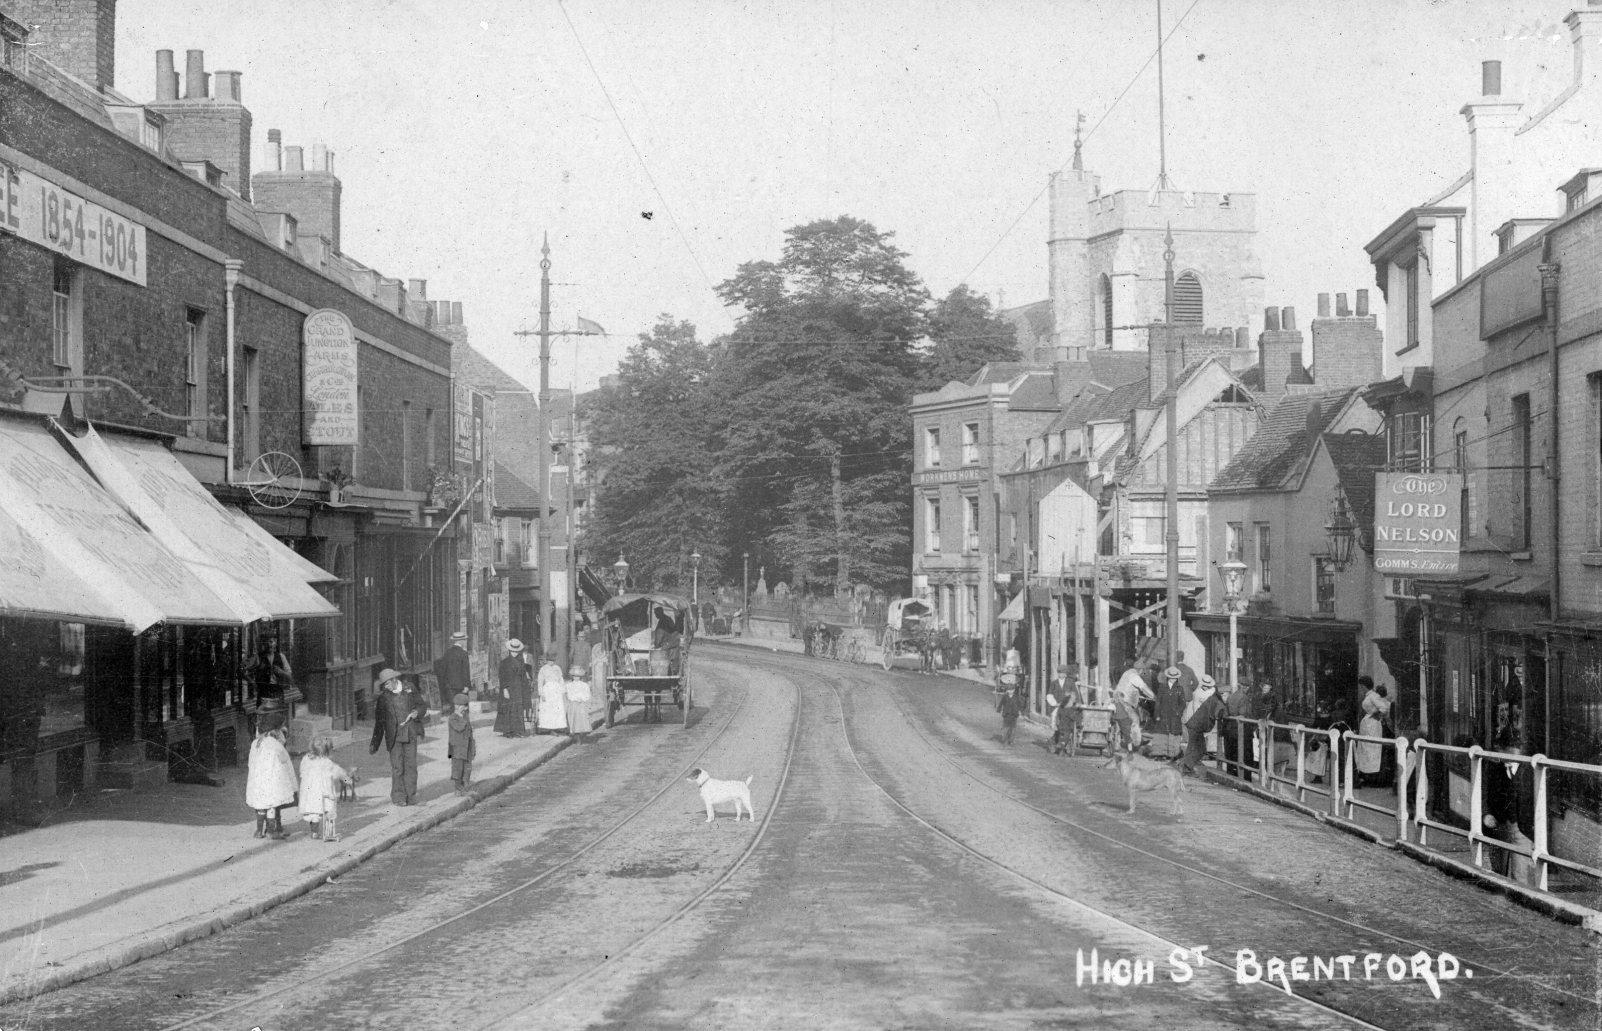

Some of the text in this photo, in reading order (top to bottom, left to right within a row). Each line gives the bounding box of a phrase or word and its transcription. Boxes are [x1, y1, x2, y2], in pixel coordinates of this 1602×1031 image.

[41, 185, 138, 277] 1854-1904
[307, 325, 344, 336] GRAND
[305, 336, 350, 348] JUNCTION
[313, 350, 349, 362] ARMS
[309, 401, 354, 413] ALES
[320, 416, 342, 424] AND
[305, 425, 356, 438] STOUT
[959, 469, 980, 480] HOME
[1387, 501, 1447, 518] LORD
[1376, 526, 1458, 542] NELSON
